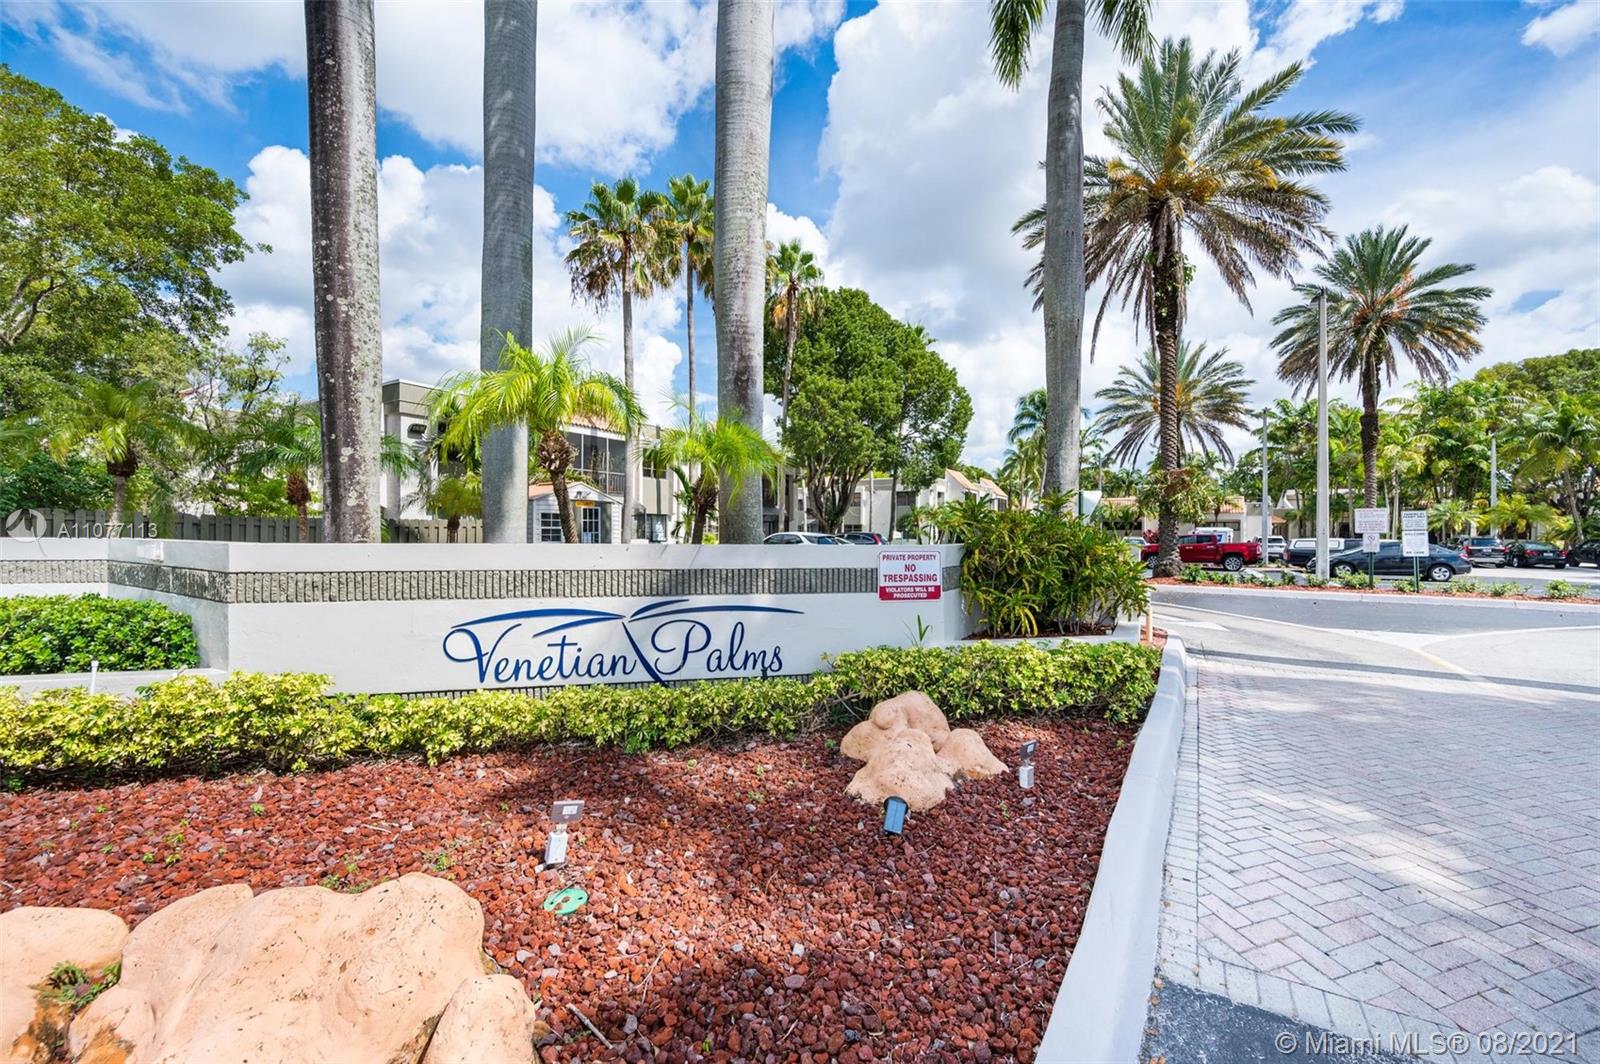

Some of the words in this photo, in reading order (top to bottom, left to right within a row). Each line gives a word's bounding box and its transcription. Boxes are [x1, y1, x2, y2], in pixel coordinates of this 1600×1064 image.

[904, 563, 917, 572] NO
[883, 573, 938, 582] TRESPASSING
[443, 623, 638, 683] Venetian
[651, 619, 784, 676] Palms
